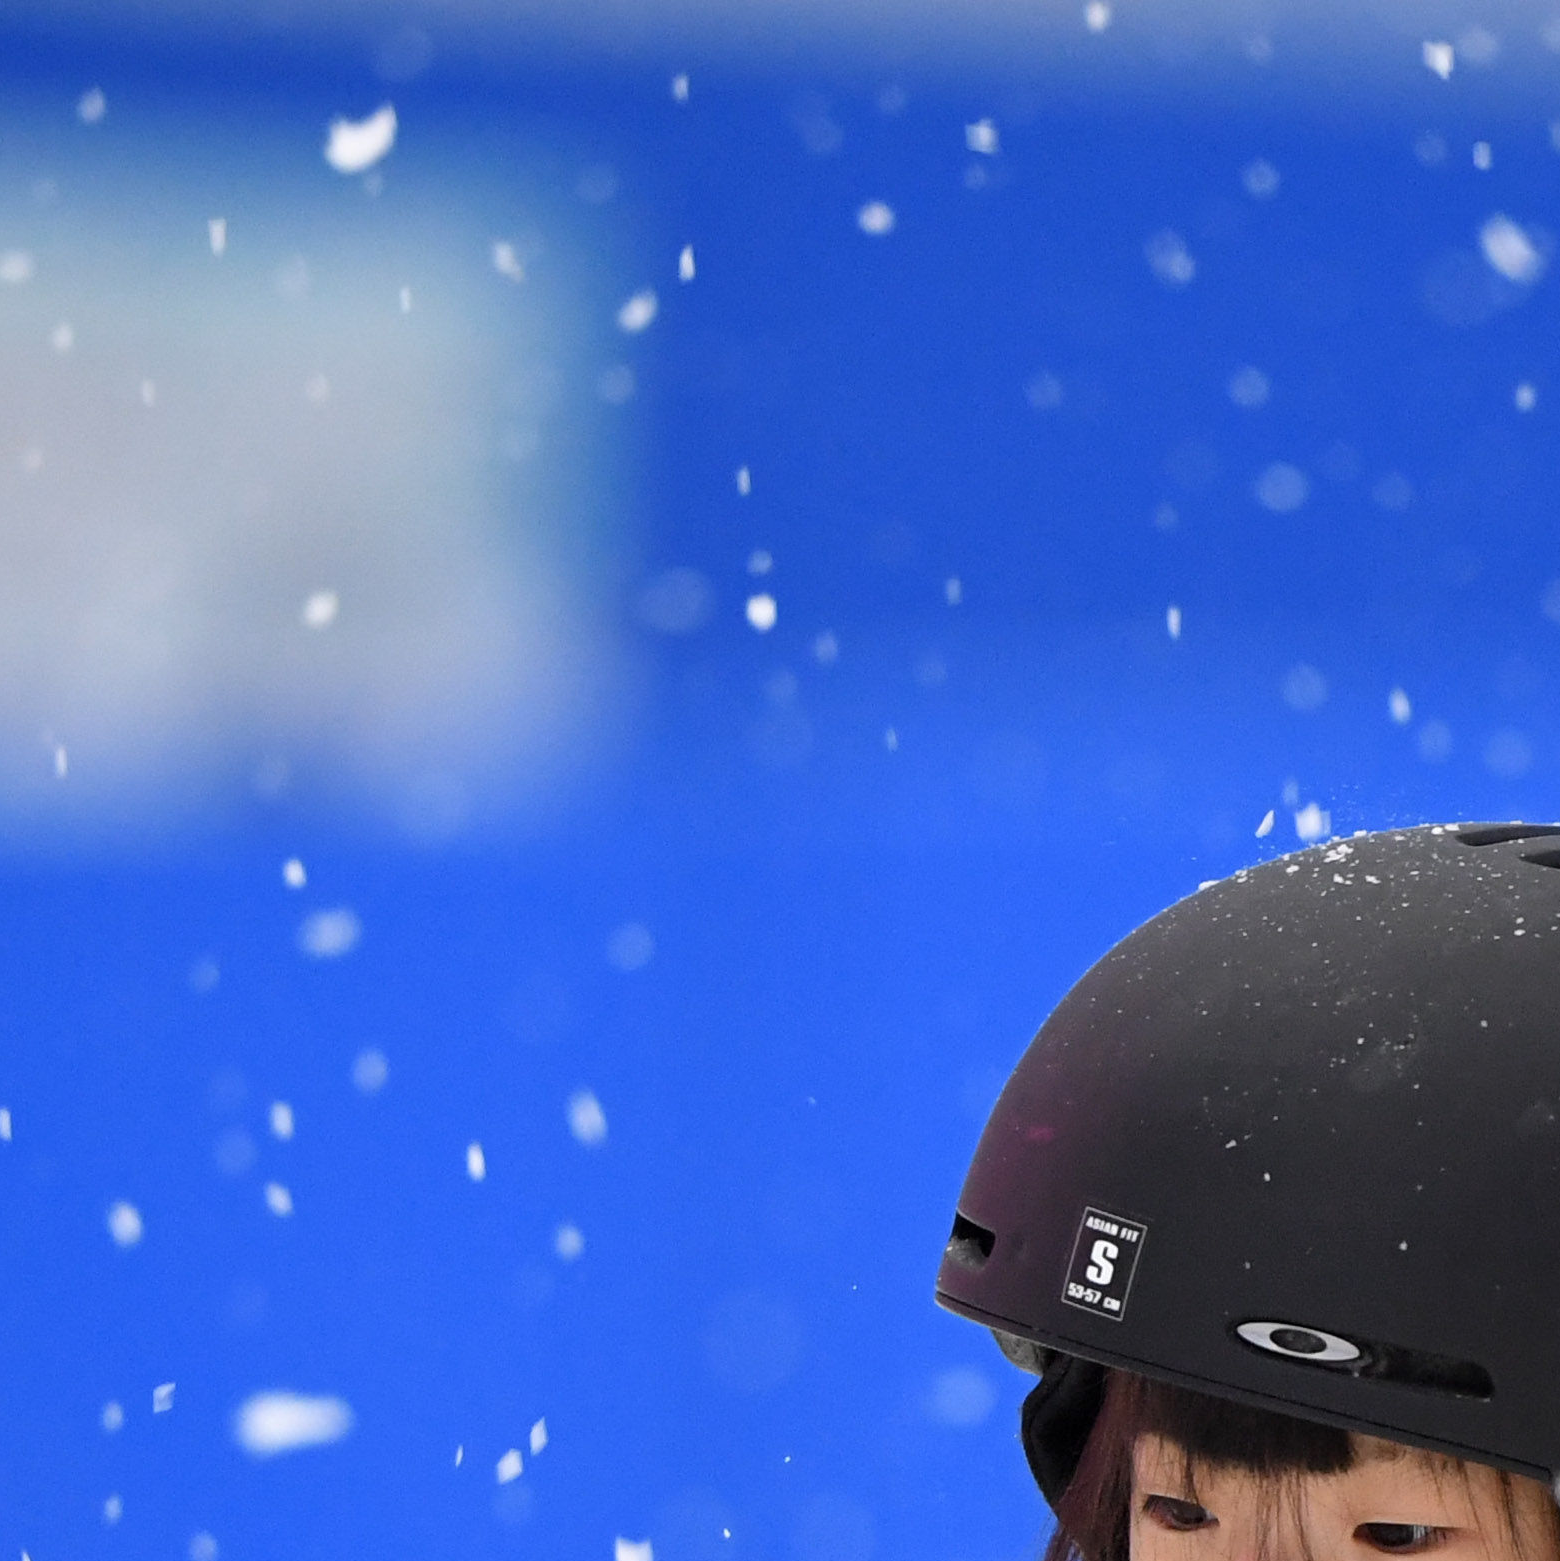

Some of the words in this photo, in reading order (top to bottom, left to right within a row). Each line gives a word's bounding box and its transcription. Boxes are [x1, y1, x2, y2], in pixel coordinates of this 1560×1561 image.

[1085, 1216, 1119, 1236] ASIAN
[1119, 1227, 1140, 1242] FIT
[1085, 1240, 1119, 1285] S
[1067, 1282, 1102, 1304] 53-57
